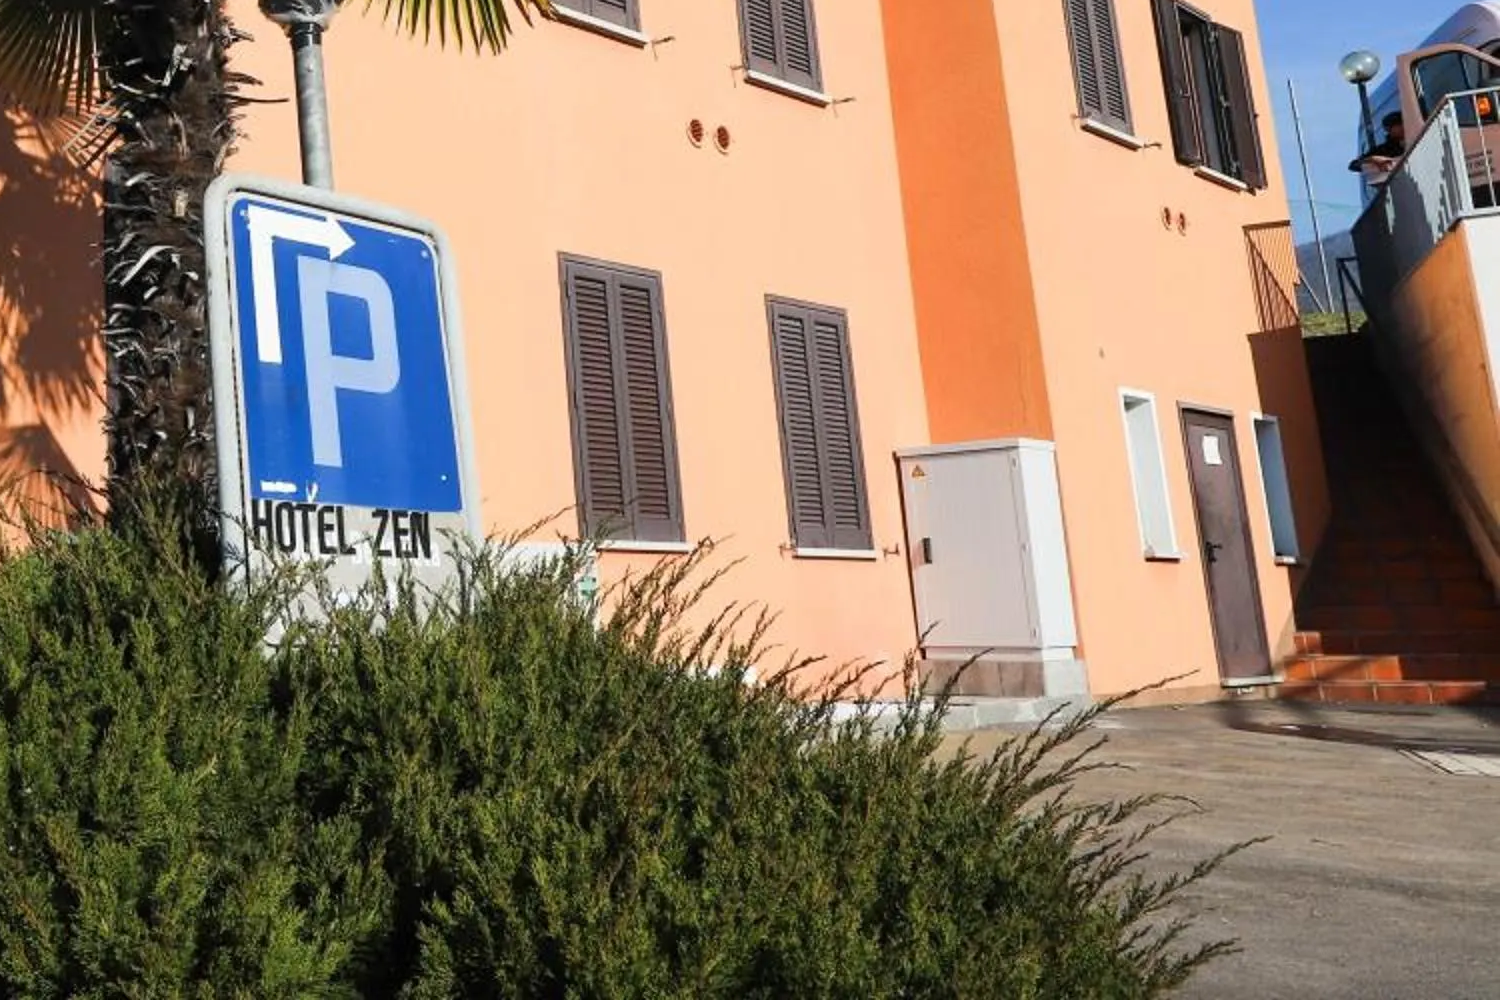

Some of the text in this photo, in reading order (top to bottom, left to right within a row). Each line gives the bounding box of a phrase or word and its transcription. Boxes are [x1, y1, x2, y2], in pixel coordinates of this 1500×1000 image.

[296, 254, 401, 469] P
[251, 499, 357, 556] HOTEL
[371, 508, 432, 560] ZEN
